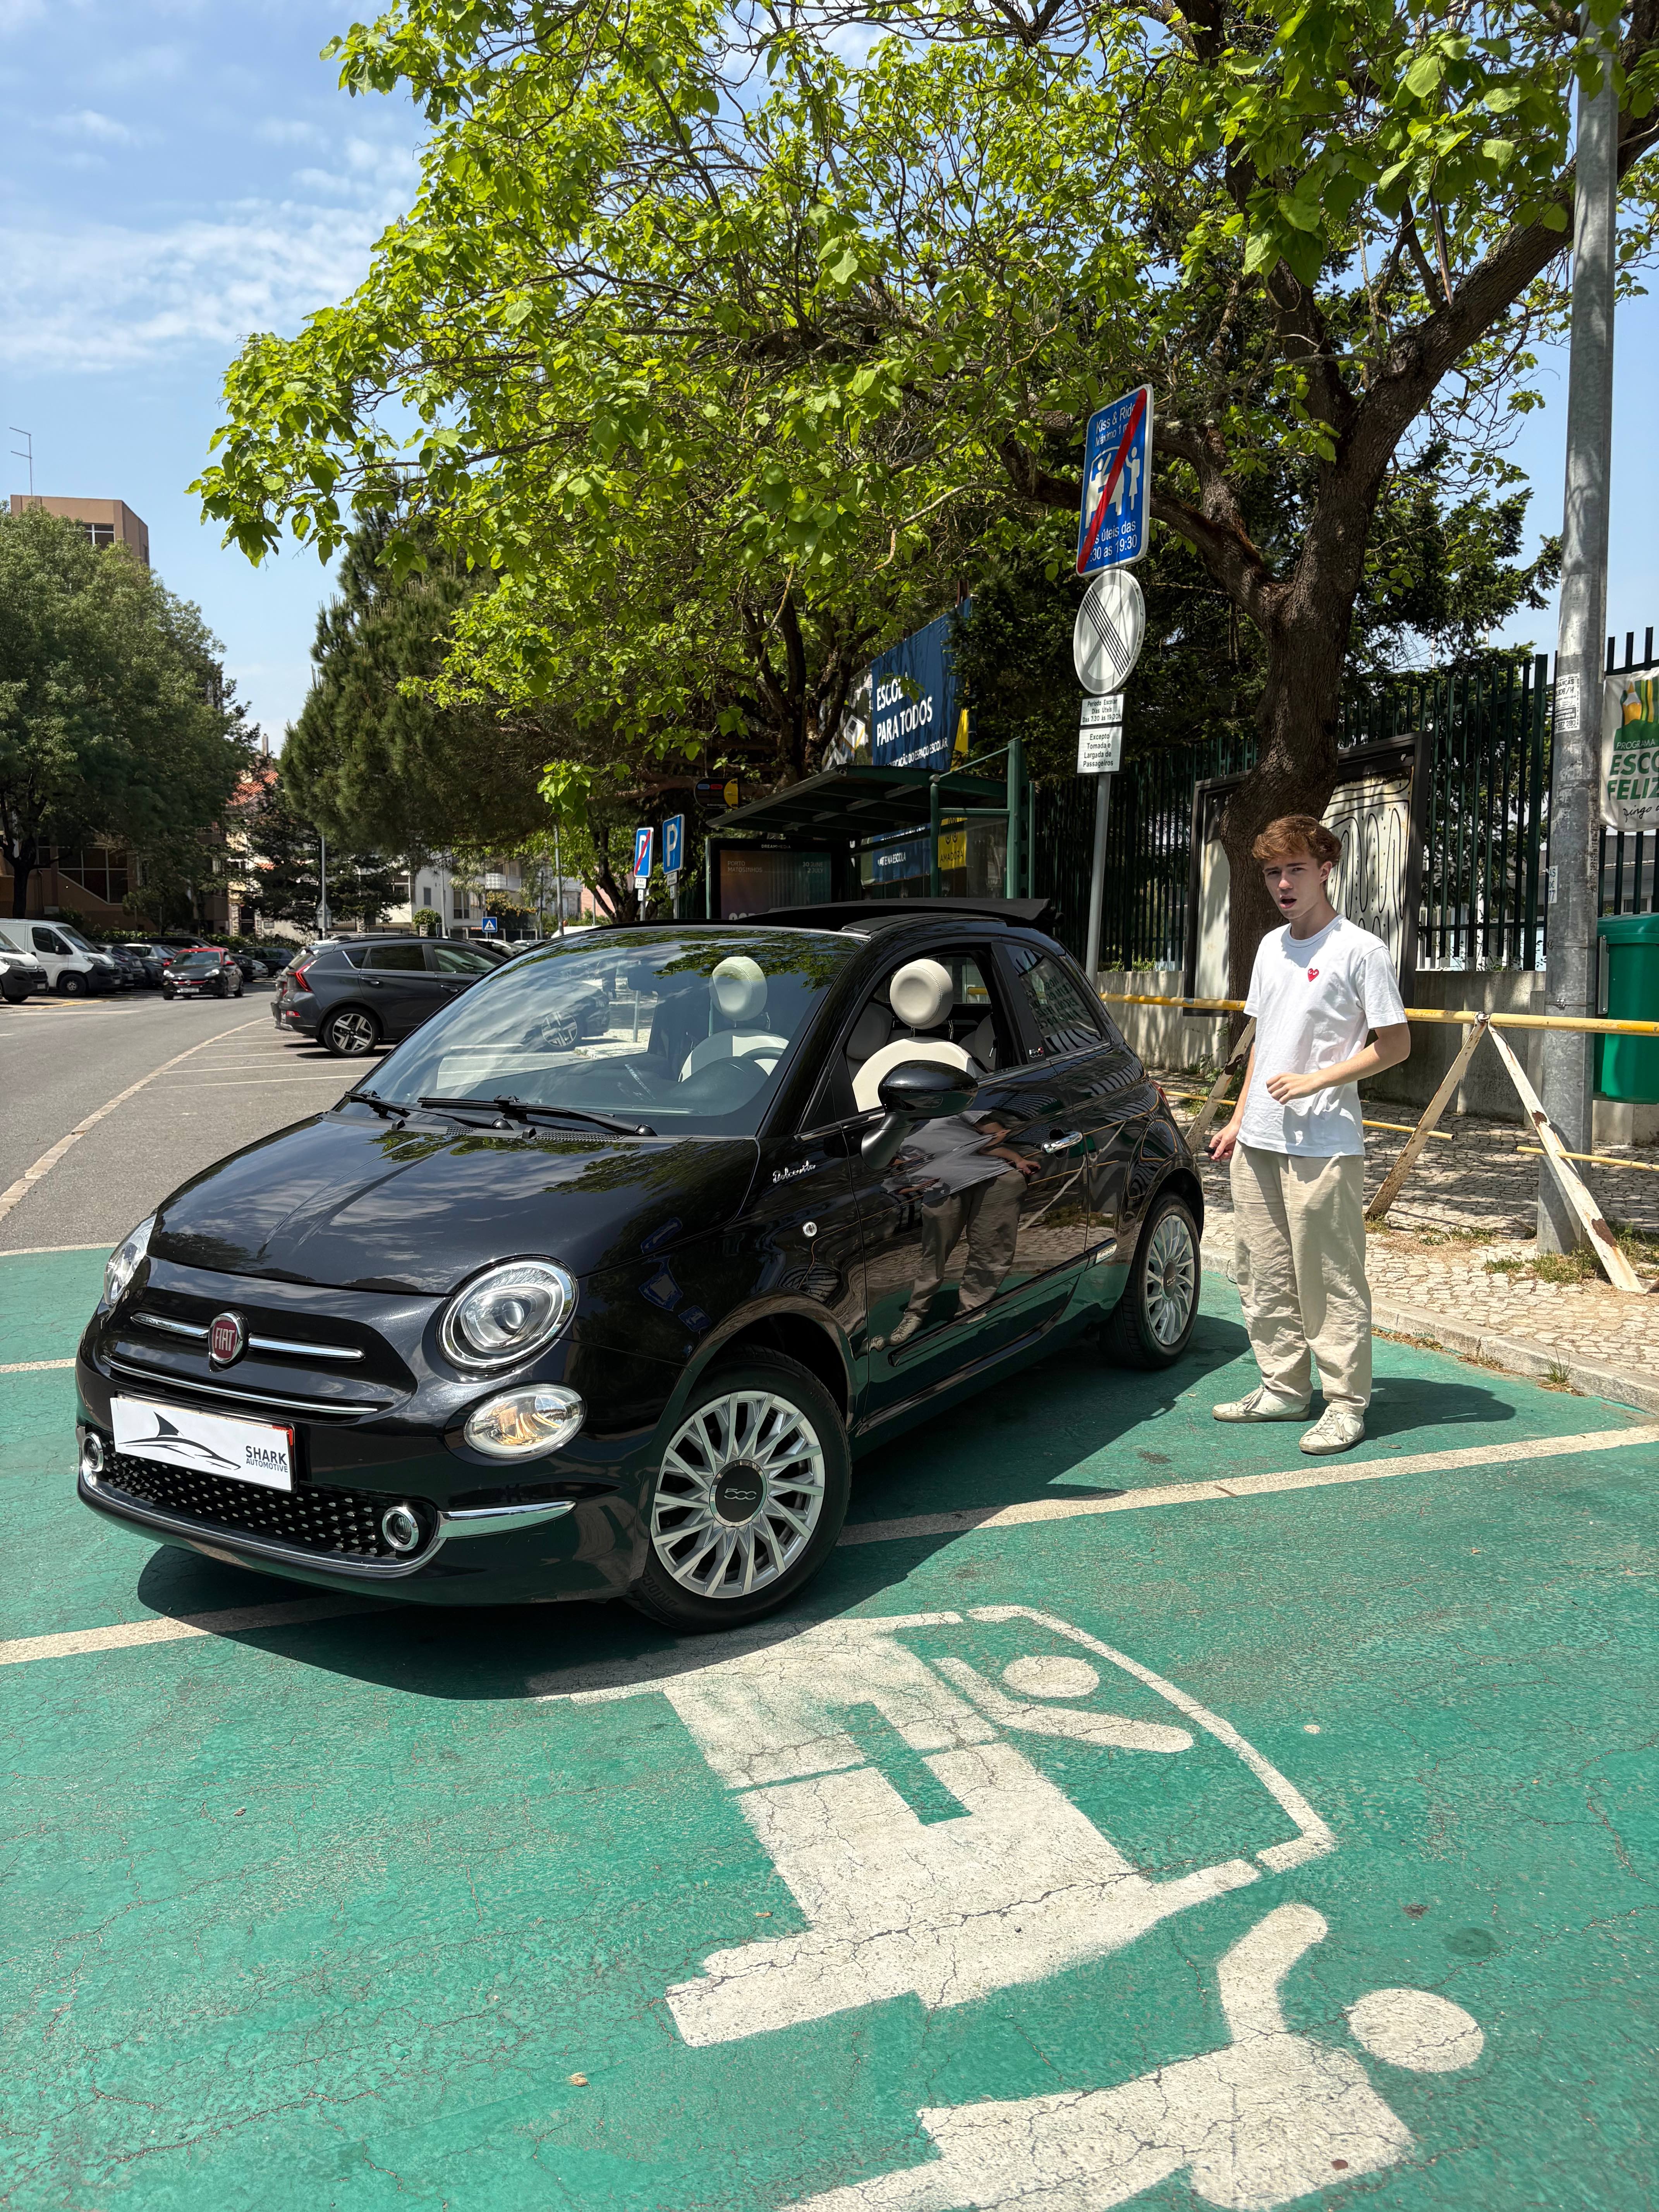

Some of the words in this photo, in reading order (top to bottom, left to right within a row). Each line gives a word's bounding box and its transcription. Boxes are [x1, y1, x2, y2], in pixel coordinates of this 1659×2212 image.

[1096, 418, 1111, 434] Kiss
[1112, 411, 1117, 425] &
[1095, 429, 1116, 447] Máximo
[1118, 424, 1121, 435] 1
[1101, 524, 1119, 542] úteis
[1121, 520, 1136, 535] das
[1086, 546, 1102, 563] :30
[1103, 545, 1112, 558] as
[1115, 534, 1137, 554] 19:30
[876, 672, 910, 712] ESCOL
[876, 716, 899, 747] PARA
[900, 696, 933, 735] TODOS
[929, 737, 948, 754] ESCOLAR
[1084, 751, 1104, 759] Largada
[1616, 738, 1656, 750] PROGRAMA
[1083, 759, 1113, 768] Passageiros
[1607, 776, 1659, 801] FELIZ
[667, 823, 678, 868] P
[940, 850, 963, 863] AMADORA
[215, 1327, 235, 1351] FIAT
[245, 1445, 287, 1466] SHARK
[246, 1458, 288, 1473] AUTOMOTIVE
[724, 1488, 757, 1500] 500
